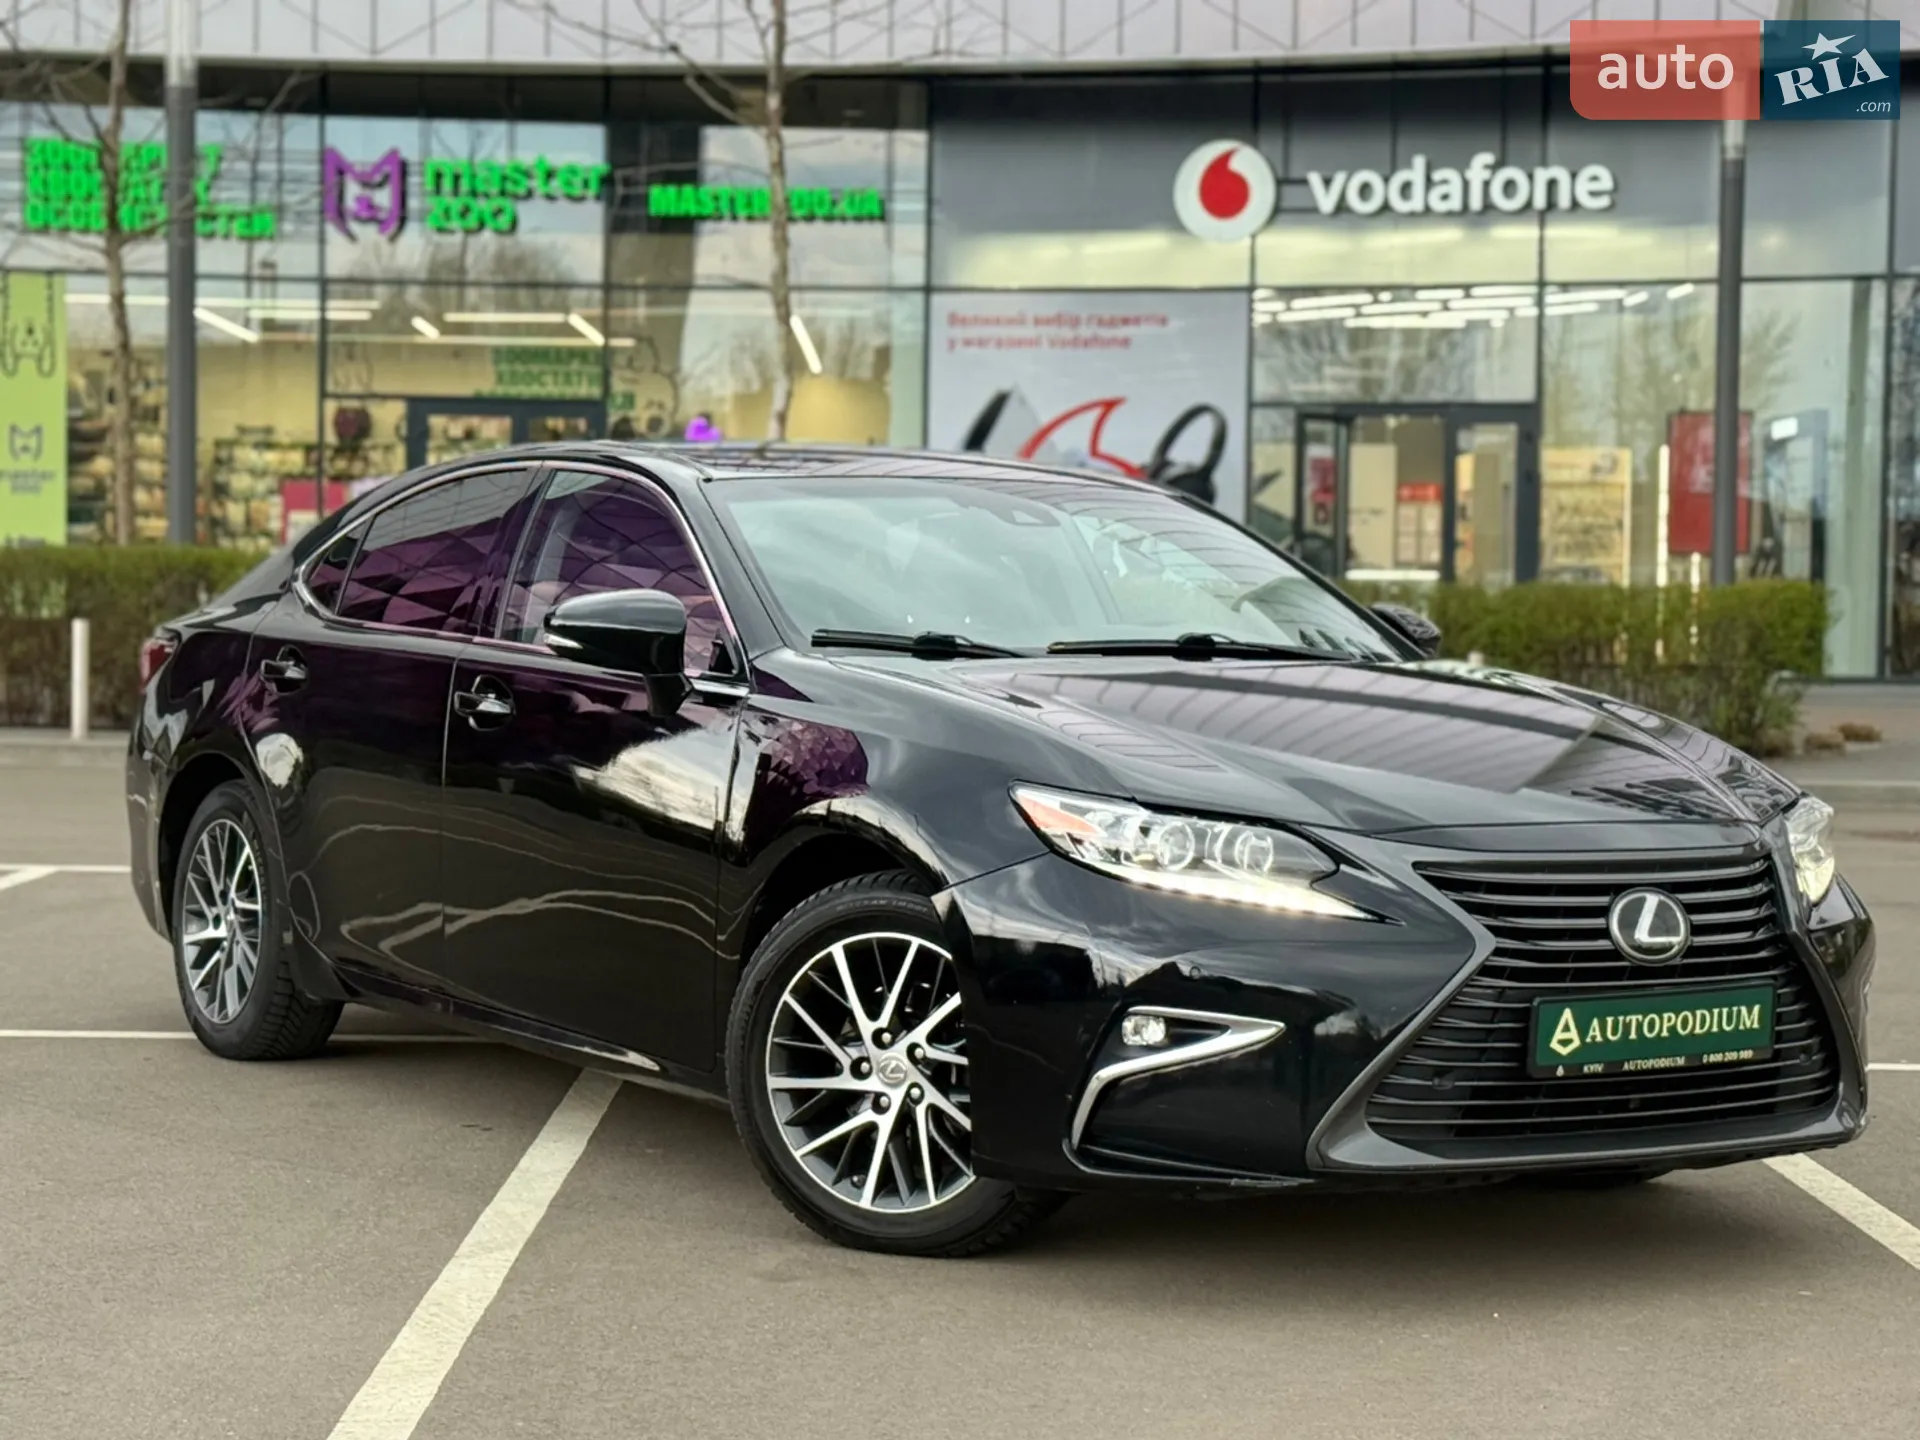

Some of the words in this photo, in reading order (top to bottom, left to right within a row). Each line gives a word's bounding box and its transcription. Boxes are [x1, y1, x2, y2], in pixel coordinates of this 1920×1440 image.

[423, 154, 611, 196] master
[1307, 152, 1615, 215] vodafone
[1585, 1003, 1761, 1044] AUTOPODIUM
[1582, 1062, 1605, 1075] KYIV
[1621, 1055, 1686, 1072] AUTOPODIUM
